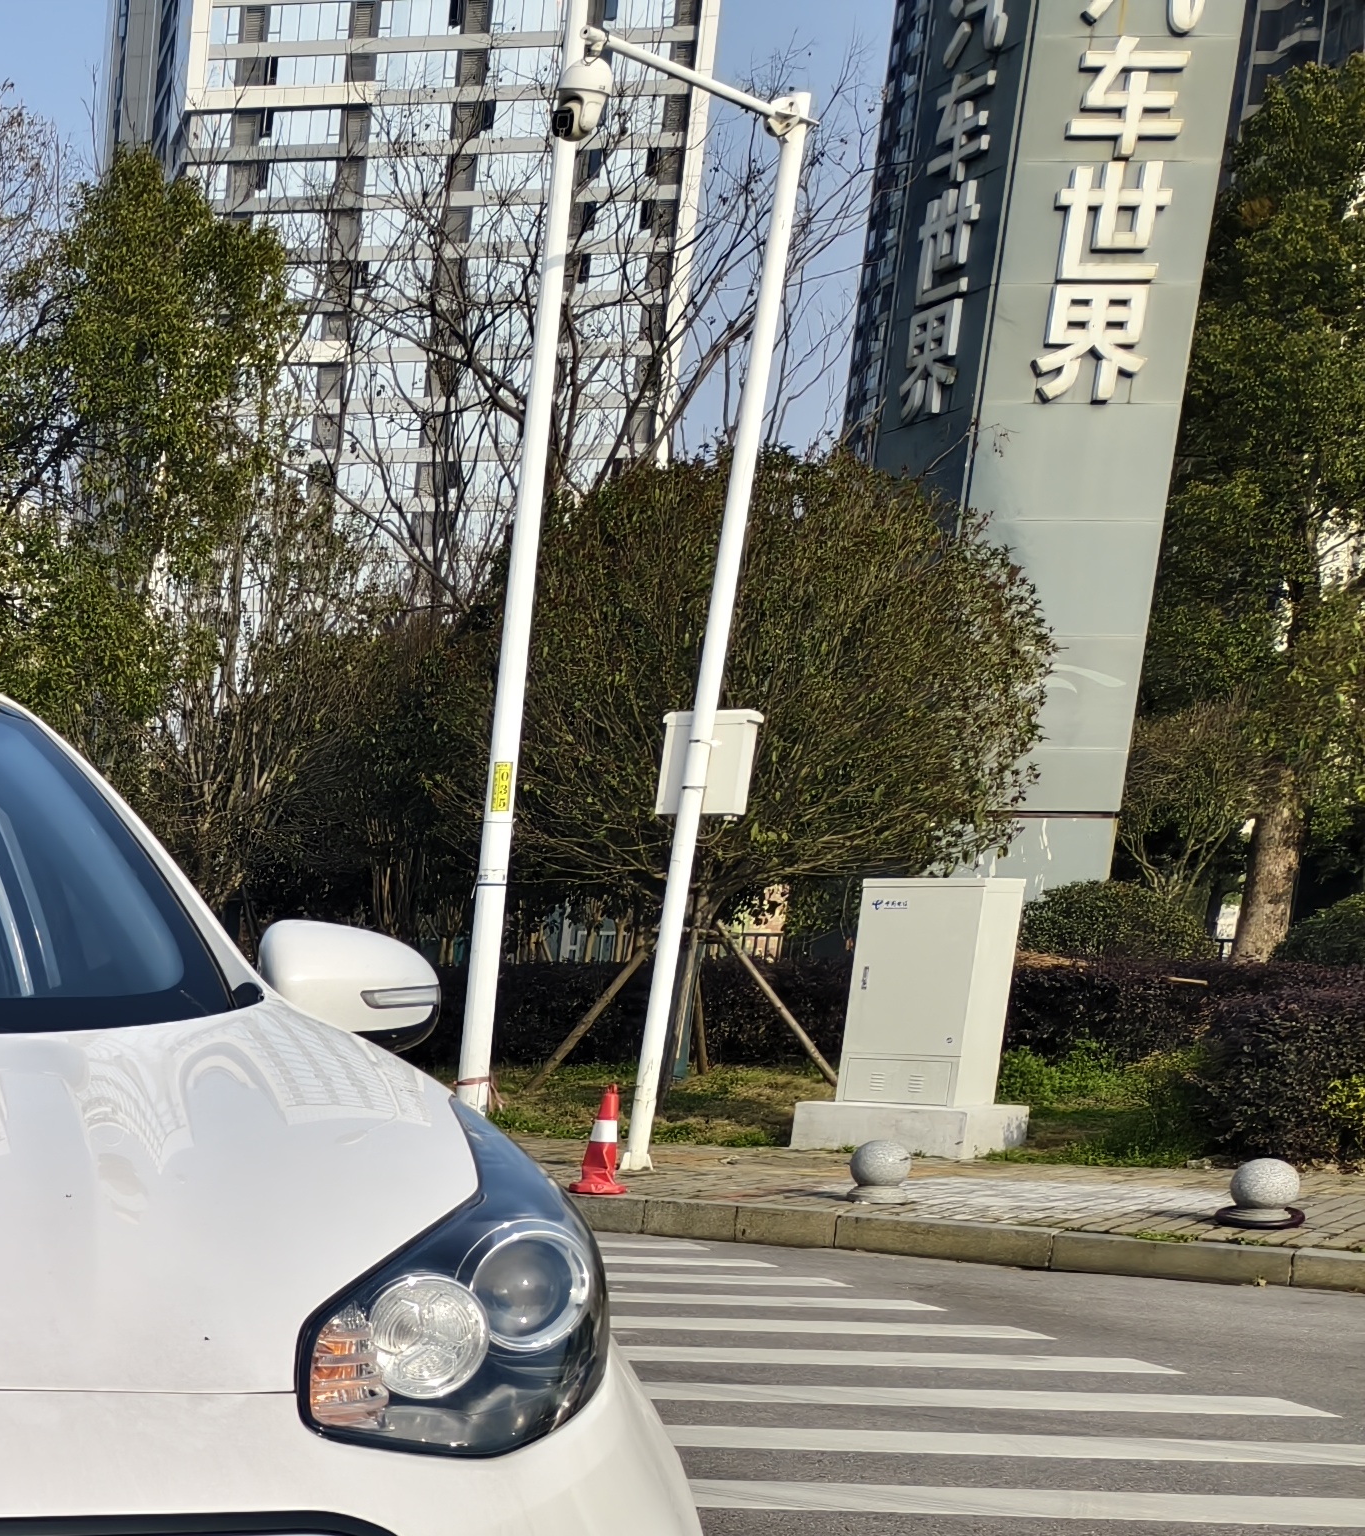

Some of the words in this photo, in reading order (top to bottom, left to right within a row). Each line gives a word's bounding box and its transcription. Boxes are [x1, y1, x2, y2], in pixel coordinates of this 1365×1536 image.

[1030, 0, 1208, 404] 车世界
[498, 771, 509, 808] 035
